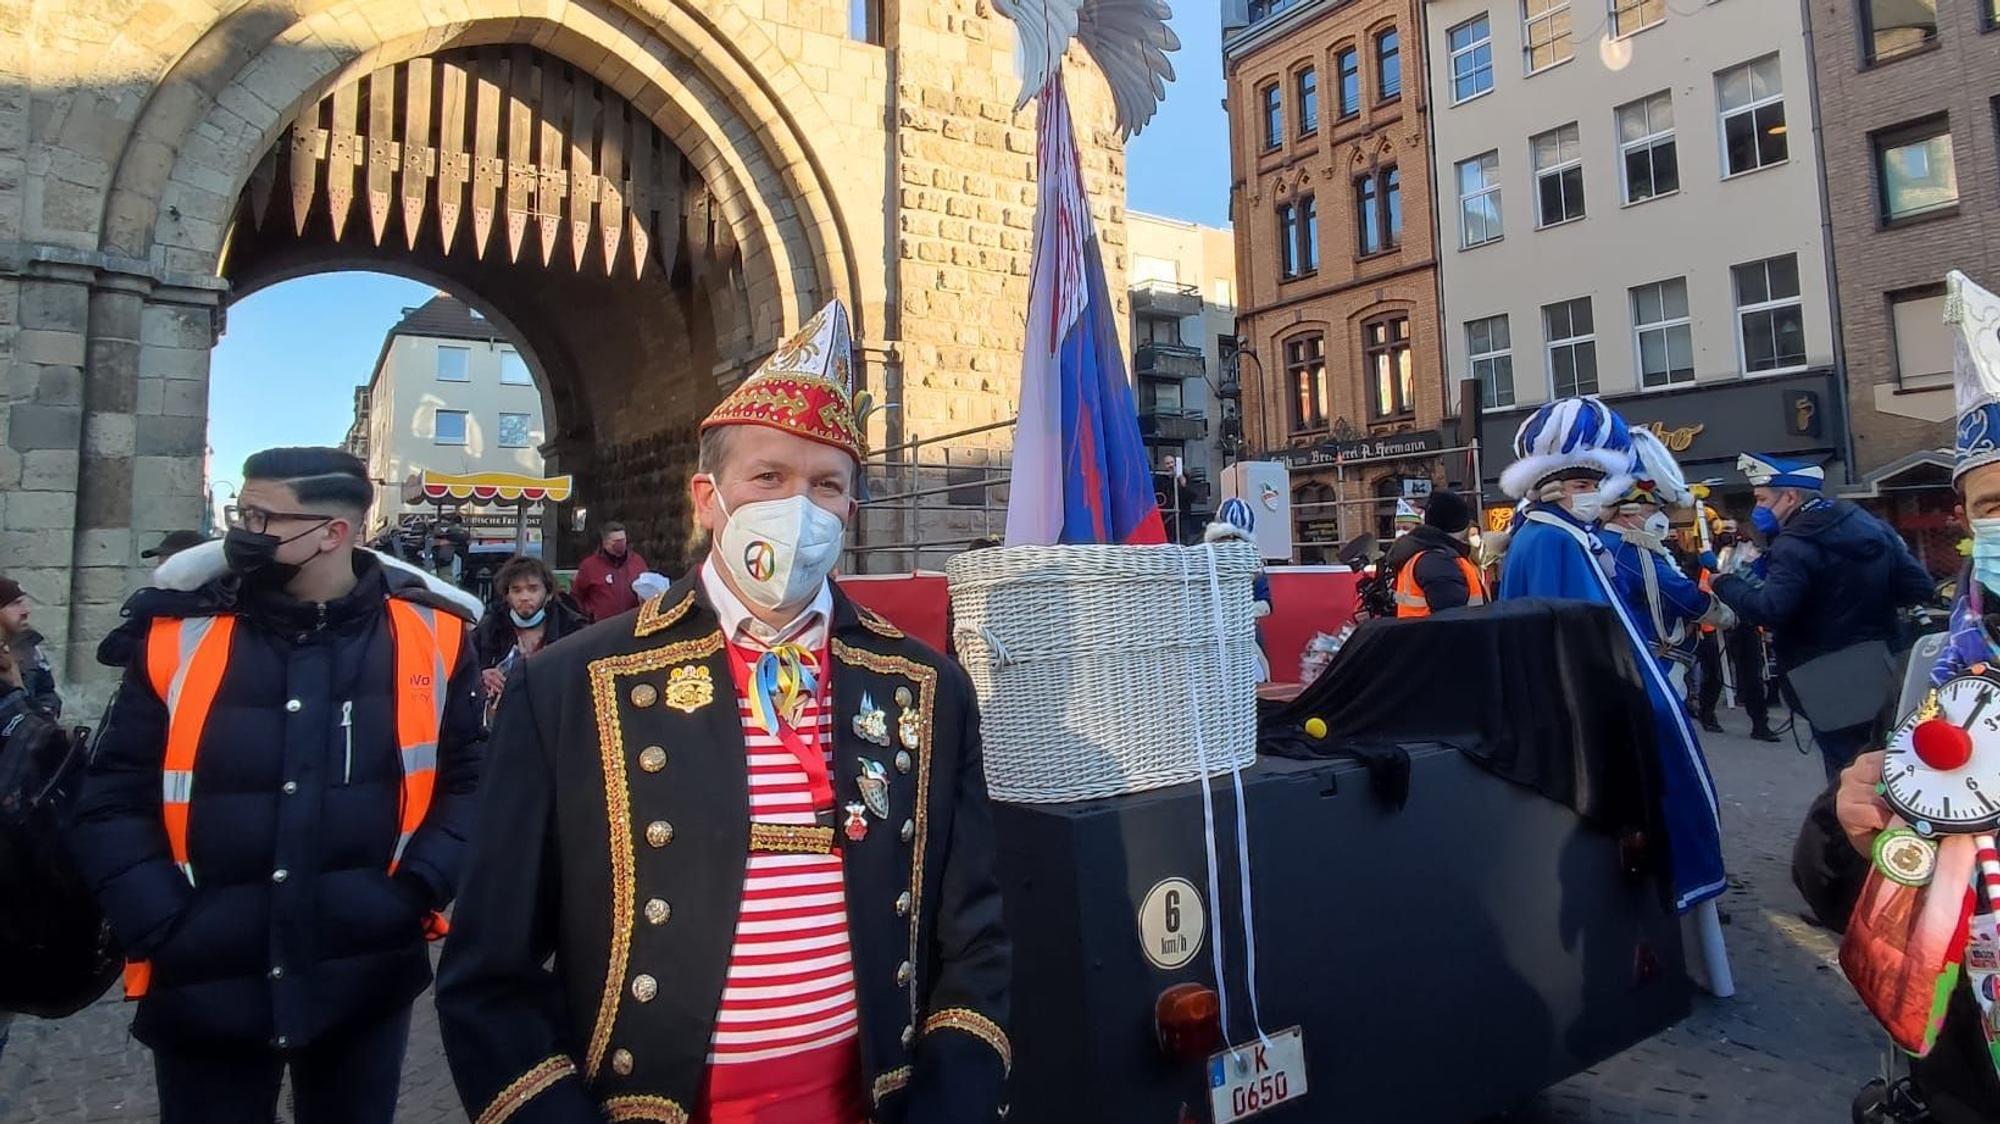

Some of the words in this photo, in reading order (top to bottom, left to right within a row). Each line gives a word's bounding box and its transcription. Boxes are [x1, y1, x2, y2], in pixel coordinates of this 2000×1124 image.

[1966, 777, 1978, 790] 6
[1165, 889, 1180, 933] 6
[1161, 934, 1187, 955] km/h
[1255, 1046, 1268, 1074] K
